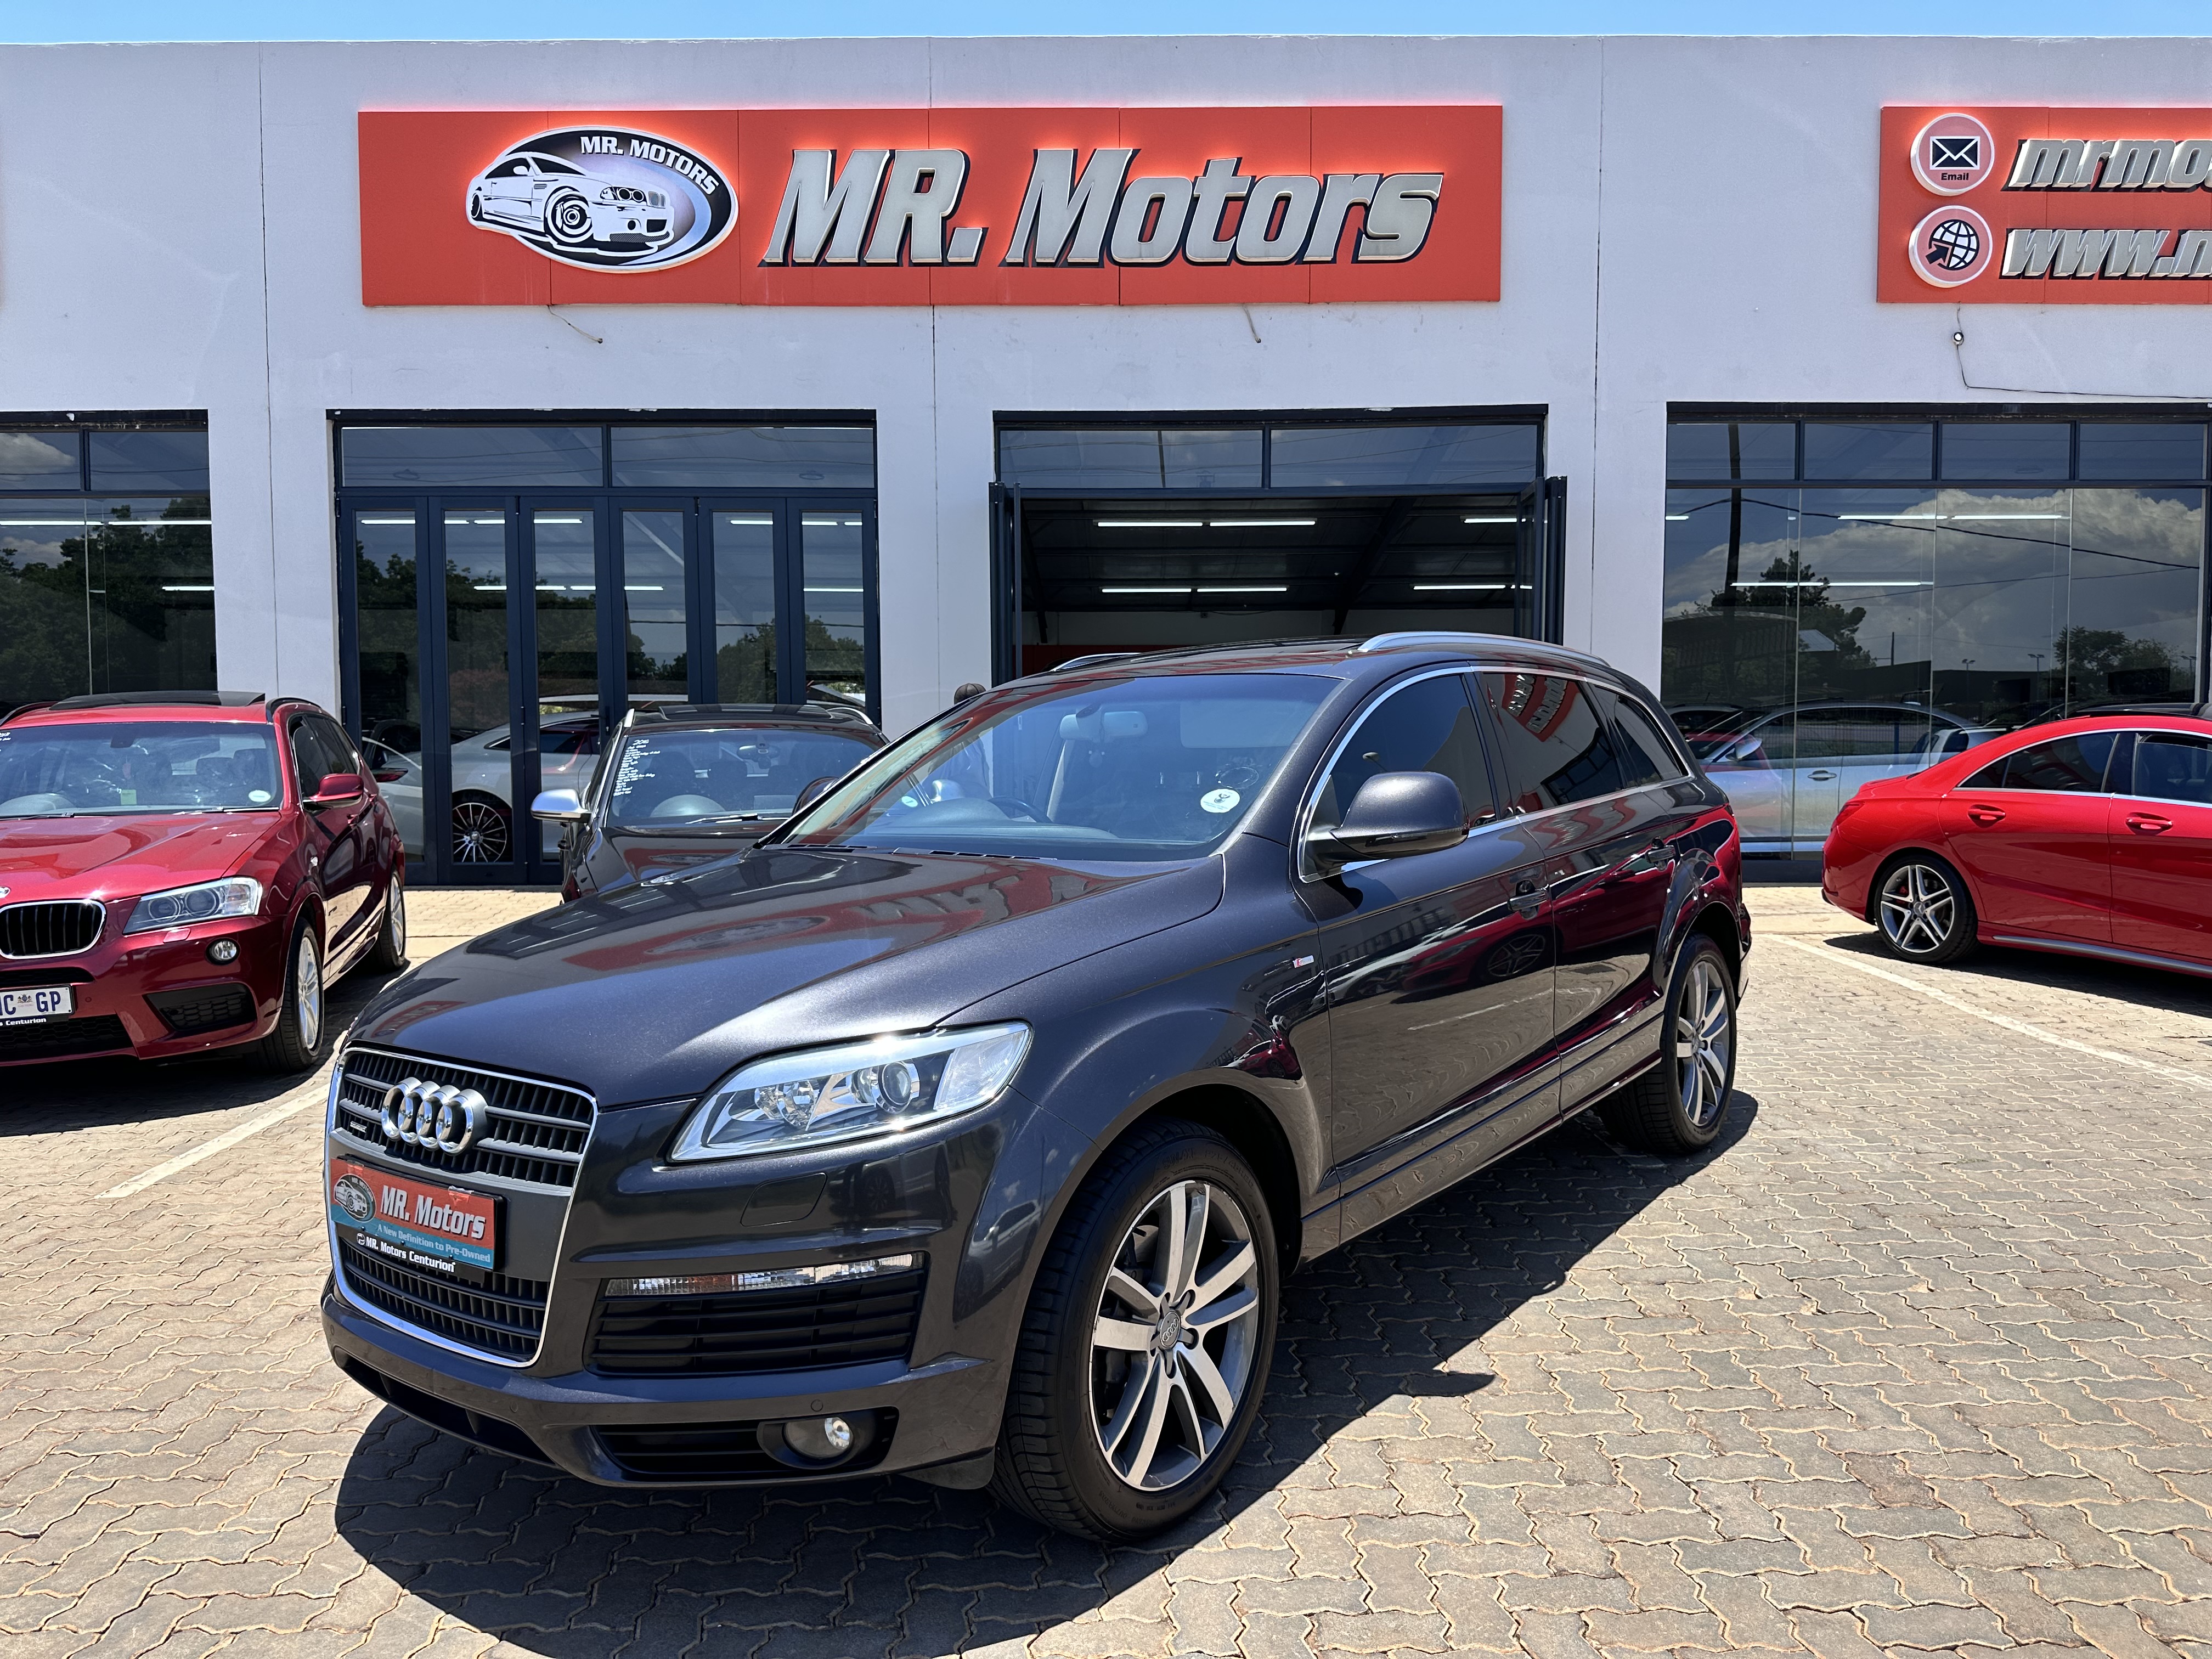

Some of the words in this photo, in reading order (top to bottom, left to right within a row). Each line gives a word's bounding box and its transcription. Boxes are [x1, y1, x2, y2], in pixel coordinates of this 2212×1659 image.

[580, 137, 624, 154] MR.
[630, 139, 719, 195] MOTORS
[1941, 172, 1969, 180] Email
[2006, 139, 2212, 189] mrmo
[763, 149, 985, 266] MR.
[1004, 149, 1444, 266] Motors
[5, 1018, 47, 1026] Centurion
[36, 991, 61, 1013] GP
[380, 1185, 410, 1221] MR.
[414, 1194, 486, 1239] Motors
[365, 1236, 379, 1250] MR.
[380, 1241, 407, 1259] Motors
[409, 1250, 455, 1273] Centurion
[377, 1223, 382, 1232] A
[382, 1225, 397, 1238] New
[398, 1229, 433, 1248] Definition
[435, 1242, 444, 1251] to
[445, 1244, 491, 1263] Pre-Owned
